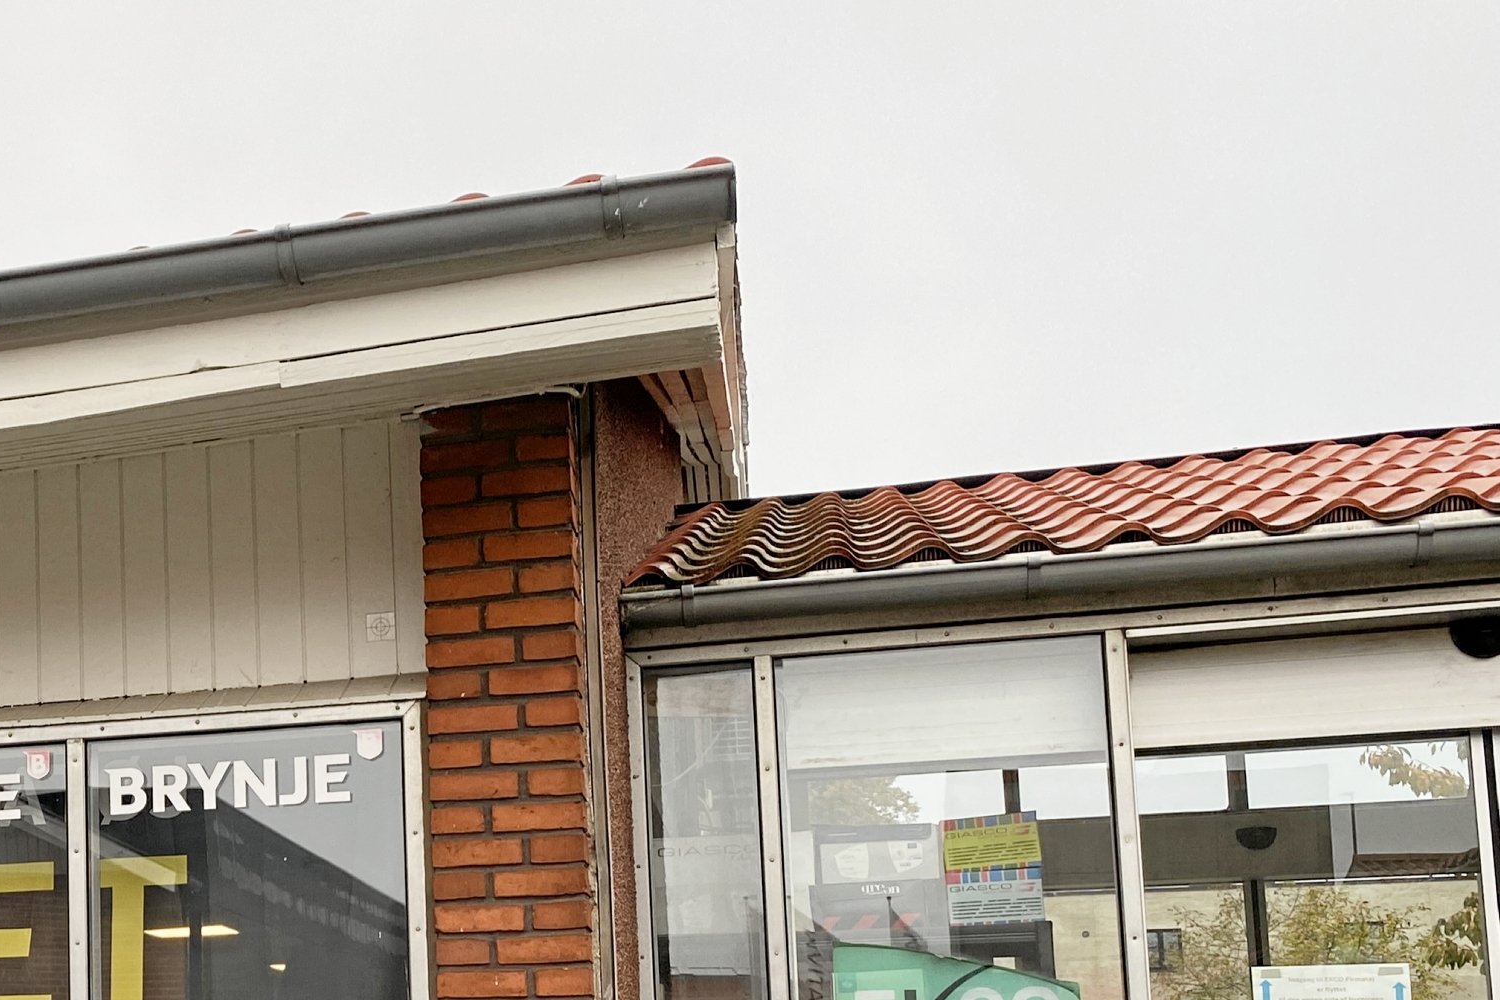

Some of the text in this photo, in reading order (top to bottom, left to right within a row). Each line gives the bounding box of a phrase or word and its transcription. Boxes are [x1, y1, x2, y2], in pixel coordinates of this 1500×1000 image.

[104, 753, 352, 816] BRYNJE
[945, 827, 1008, 839] GIASCO
[949, 883, 1013, 893] GIASCO
